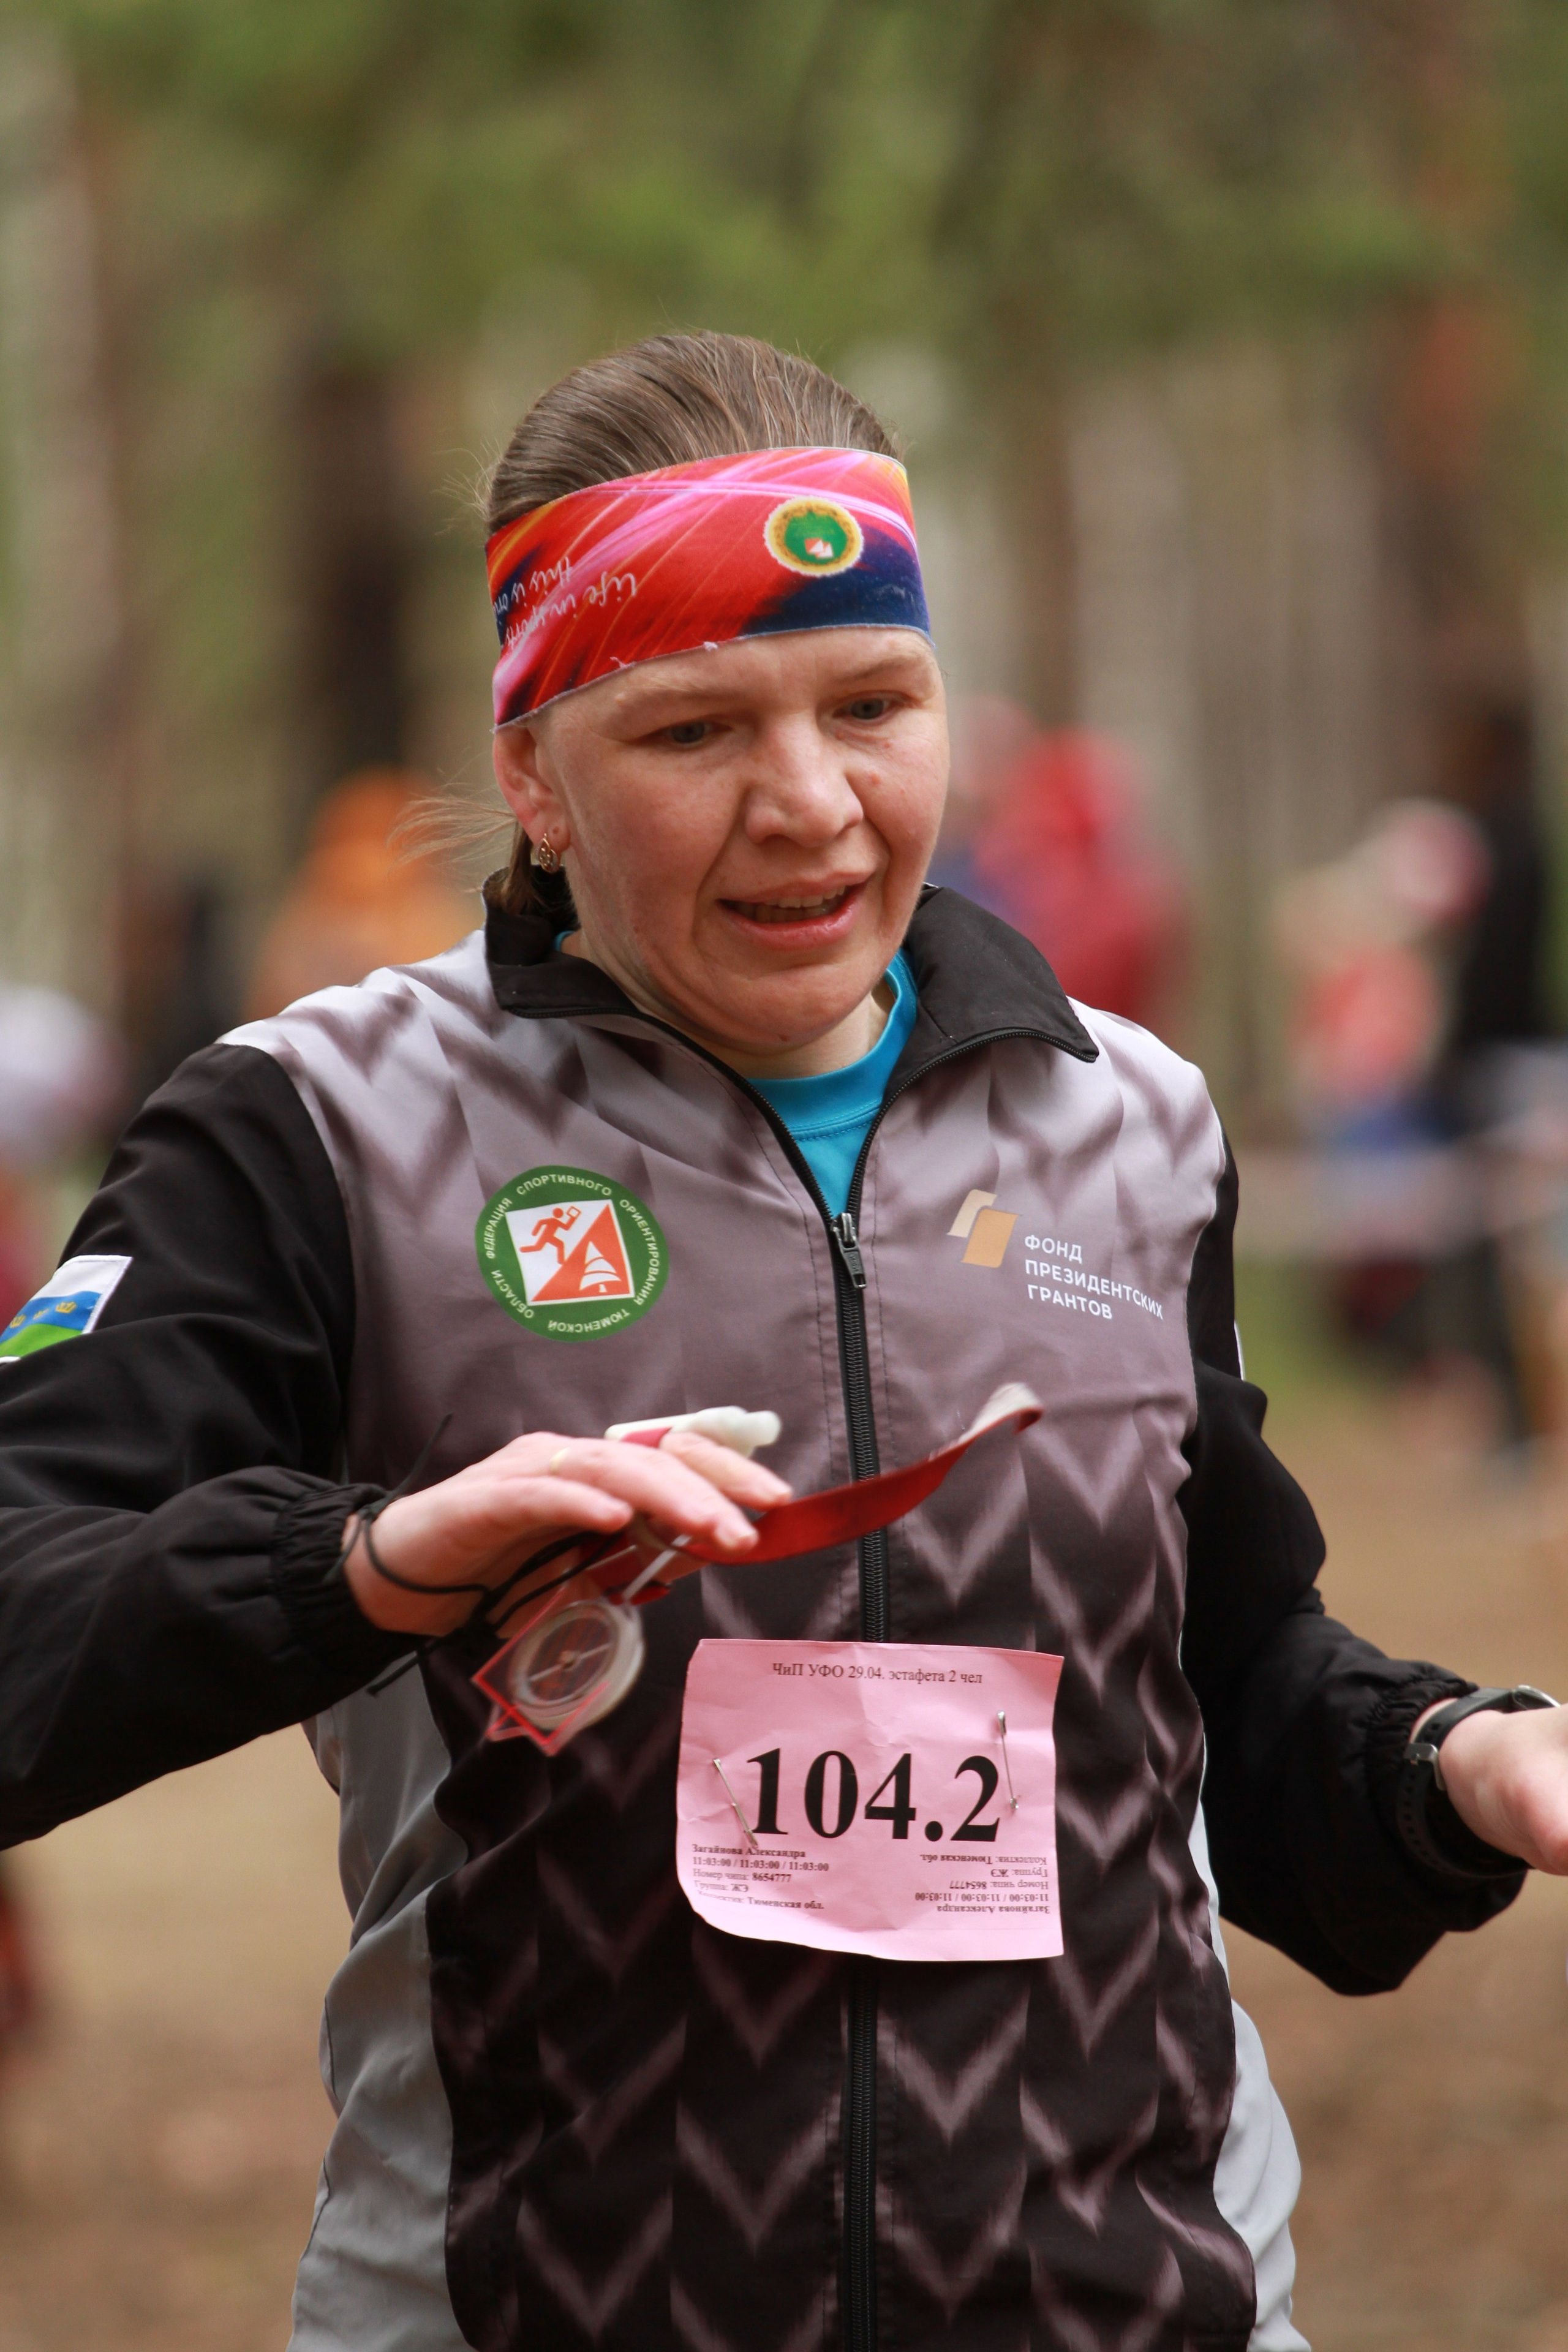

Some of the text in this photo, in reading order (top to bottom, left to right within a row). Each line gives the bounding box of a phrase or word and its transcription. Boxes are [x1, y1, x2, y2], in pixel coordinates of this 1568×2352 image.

[483, 1173, 660, 1333] ФЕДЕРАЦИЯ СПОРТИВНОГО ОРИЕНТИРОВАНИЯ ТЮМЕНСКОЙ ОБЛАСТИ
[1024, 1234, 1083, 1264] ФОНД
[1024, 1259, 1164, 1320] ПРЕЗИДЕНТСКИХ
[1027, 1284, 1112, 1320] ГРАНТОВ
[772, 1663, 983, 1684] ЧиП УФО 29.04. эстафета 2 чел
[747, 1747, 1000, 1843] 104.2
[692, 1844, 805, 1859] Загайнова Александра
[693, 1856, 731, 1867] 11:03:00
[740, 1859, 780, 1869] 11:03:00
[789, 1861, 829, 1872] 11:03:00
[919, 1854, 1047, 1865] Коллектив: Тюменская обл.
[693, 1869, 791, 1882] Номер чипа: 8654777
[990, 1868, 1048, 1877] Группа: ЖЭ
[694, 1880, 748, 1893] Группа: ЖЭ
[949, 1880, 987, 1889] 8654777
[1017, 1880, 1049, 1890] Номер
[747, 1896, 802, 1909] Тюменская
[804, 1900, 824, 1910] обл.
[914, 1892, 952, 1901] 11:03:00
[961, 1893, 1000, 1902] 11:03:00
[1010, 1893, 1049, 1902] 11:03:00
[937, 1905, 1050, 1914] Загайнова Александра
